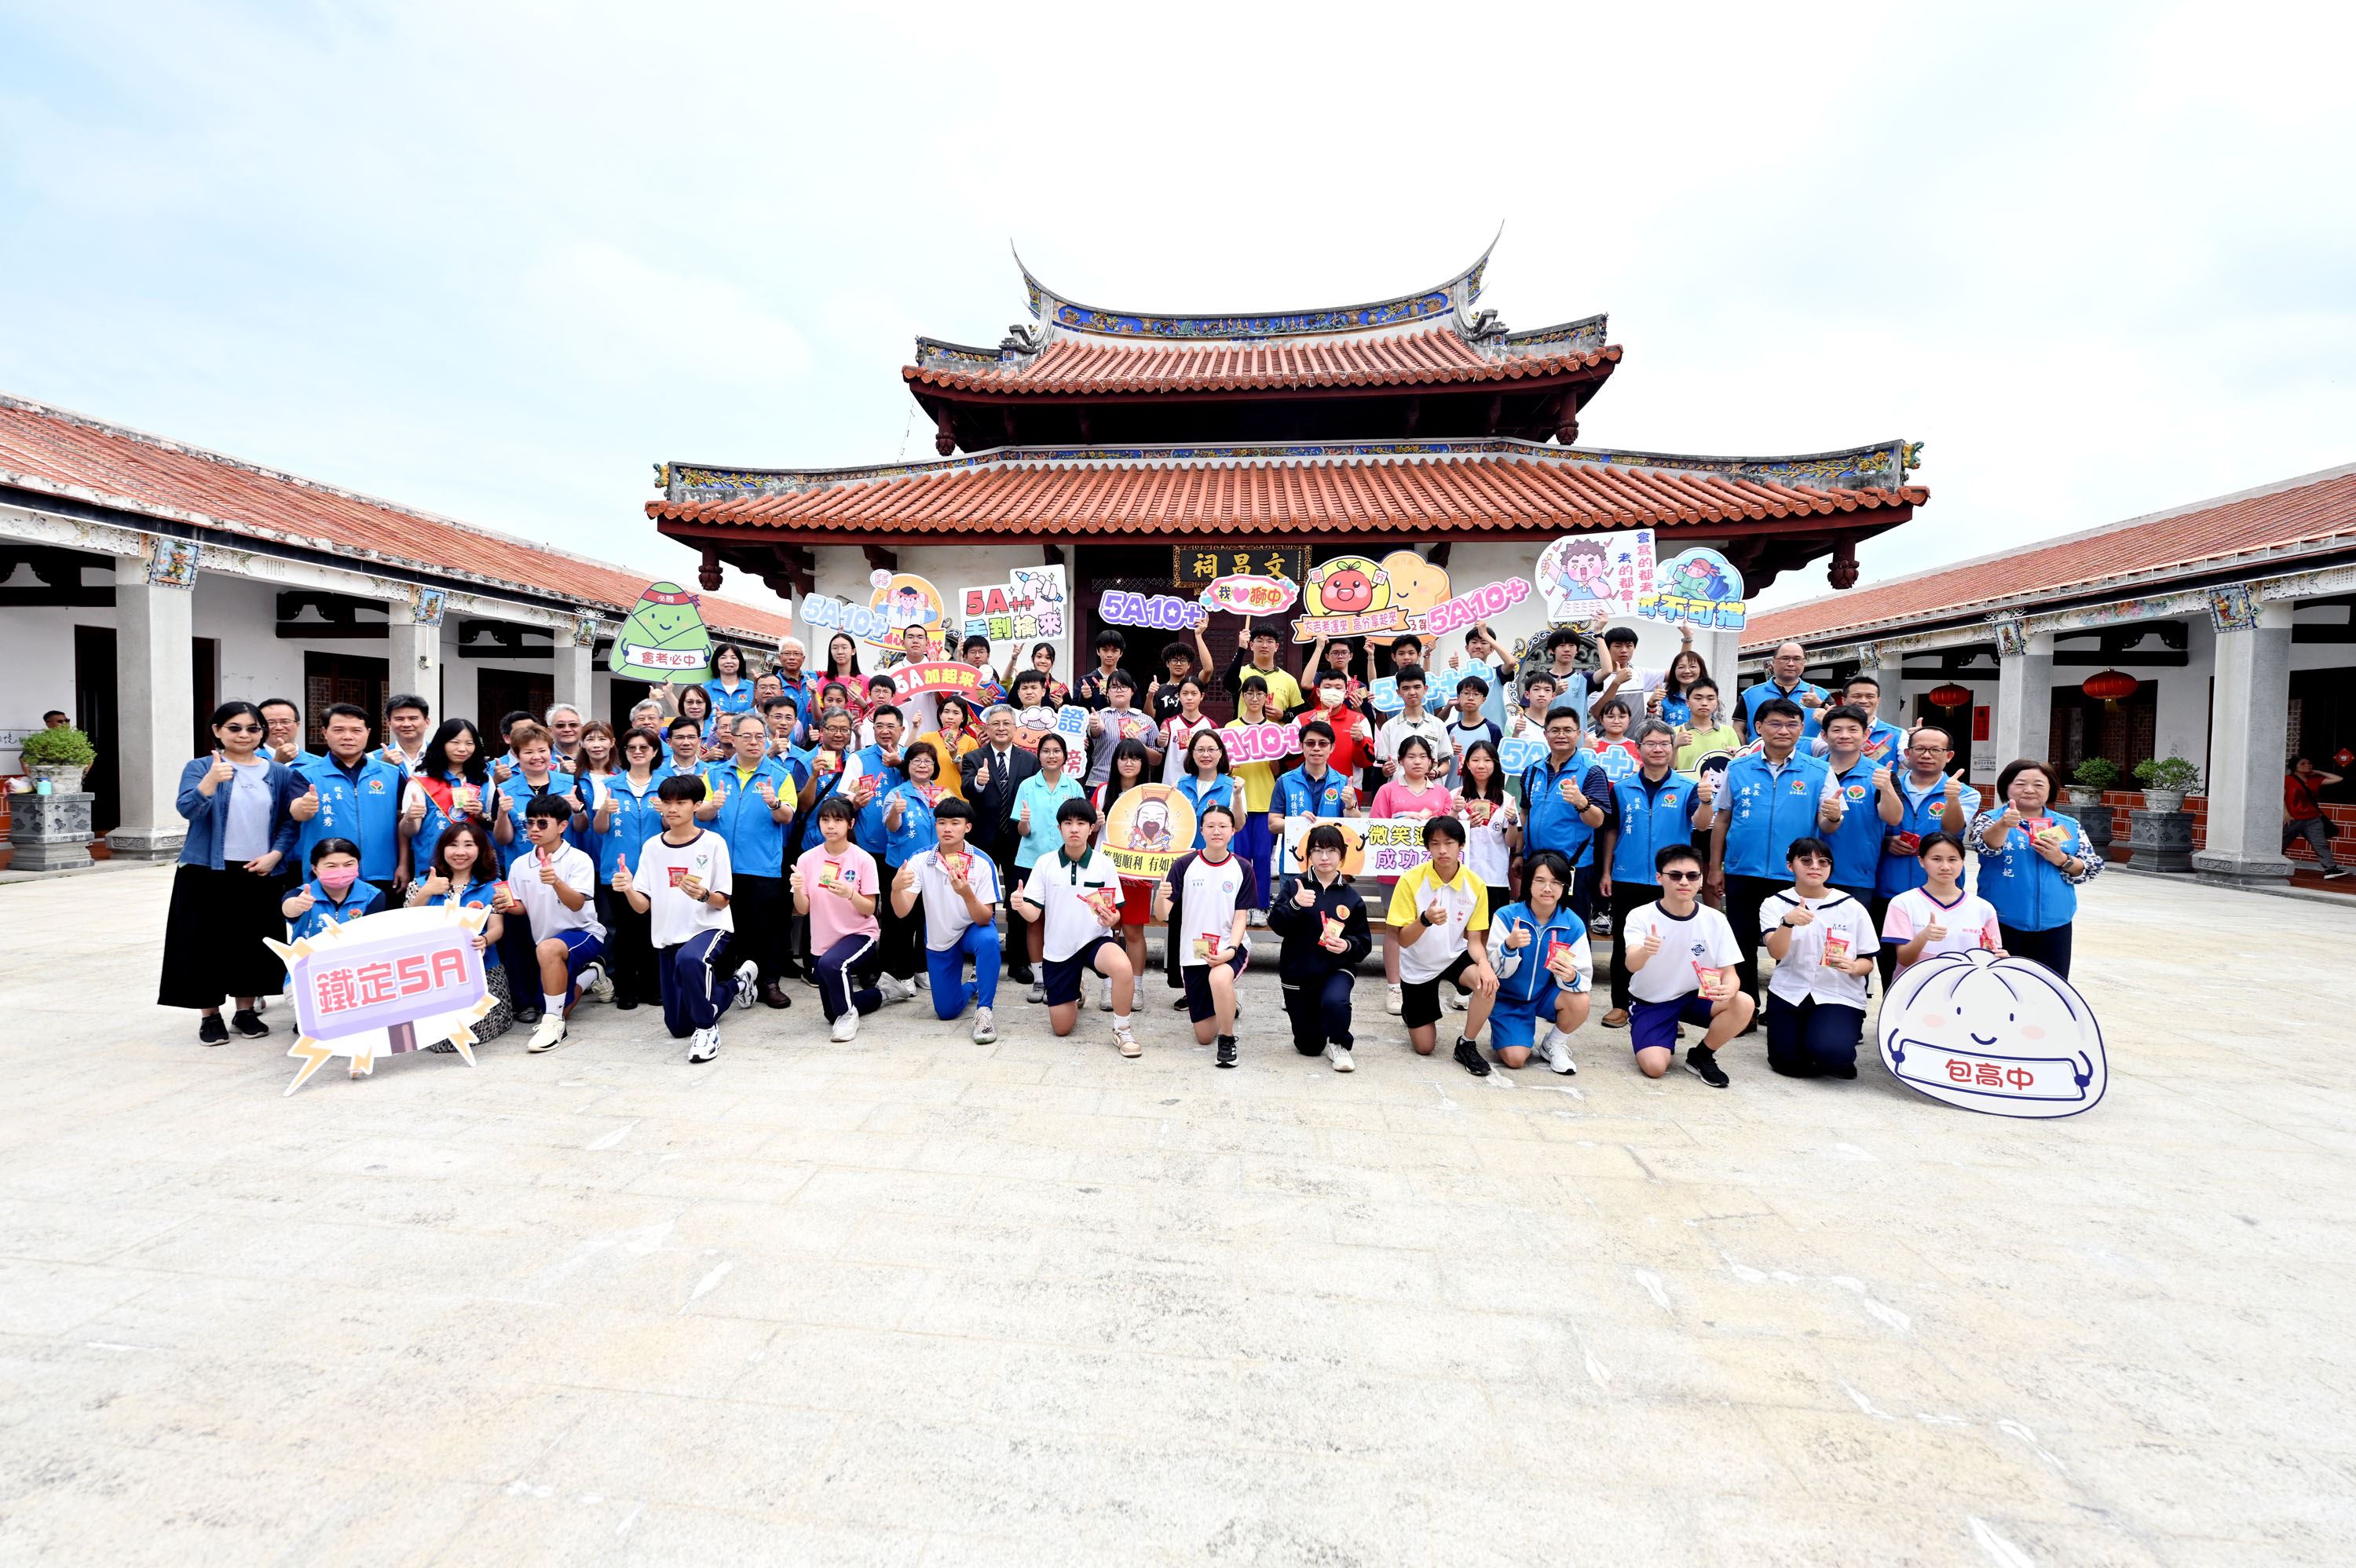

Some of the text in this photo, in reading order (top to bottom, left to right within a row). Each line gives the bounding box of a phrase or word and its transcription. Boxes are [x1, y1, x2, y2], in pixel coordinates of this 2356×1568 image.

[1635, 532, 1654, 593] 會寫的都考
[1375, 572, 1386, 584] 分
[965, 588, 1035, 616] 5A++
[1219, 586, 1231, 601] 我
[1429, 579, 1527, 632] 5A10+
[801, 594, 890, 638] 5A10+
[1101, 593, 1203, 627] 5A10+
[1304, 609, 1398, 634] 大吉考運來 高分拿起來
[642, 651, 696, 666] 會考必中
[896, 667, 976, 694] 5A加起來
[1058, 707, 1085, 734] 證
[1103, 850, 1143, 871] 題順利
[315, 947, 470, 1014] 鐵定5A
[1944, 1058, 2035, 1091] 包高中
